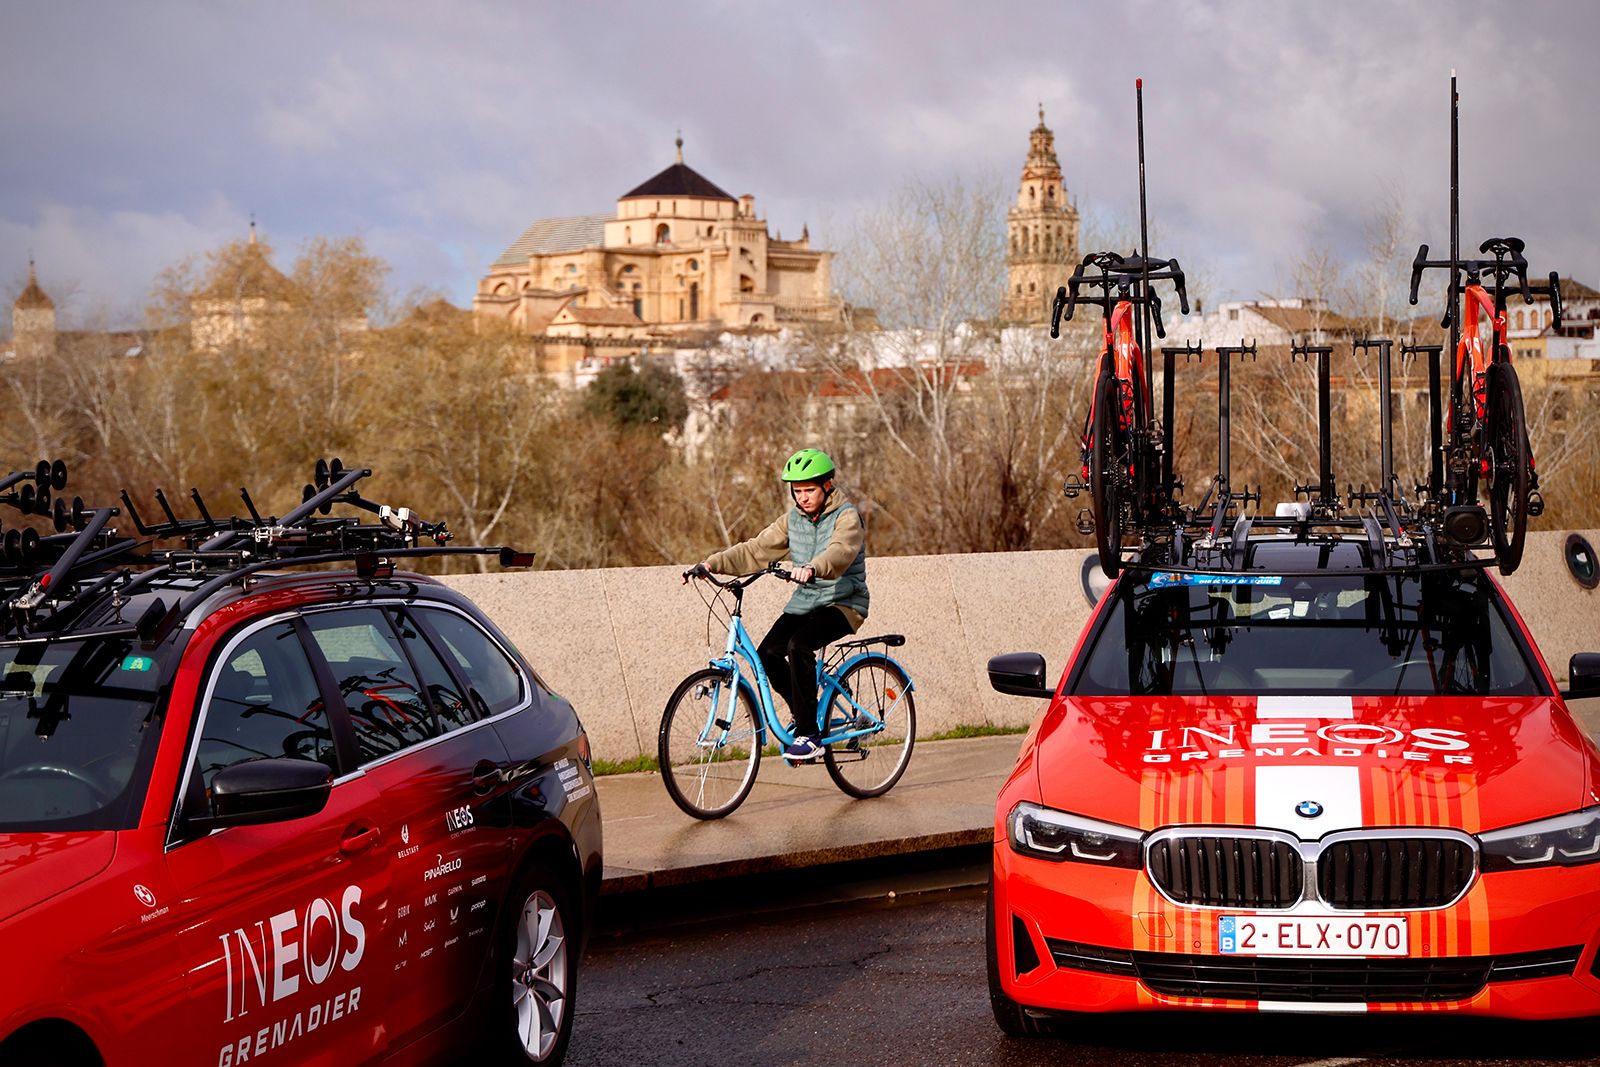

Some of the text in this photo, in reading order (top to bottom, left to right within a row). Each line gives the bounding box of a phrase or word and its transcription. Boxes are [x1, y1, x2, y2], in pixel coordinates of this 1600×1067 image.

[1148, 723, 1470, 751] INEOS
[1143, 746, 1474, 765] GRENADIER
[445, 804, 475, 832] INEOS
[397, 845, 419, 859] BELSTAFF
[423, 856, 462, 882] PINARELLO
[1222, 937, 1234, 950] B
[1241, 922, 1400, 950] 2-ELX-070
[218, 884, 366, 1024] INEOS
[217, 986, 362, 1067] GRENADIER
